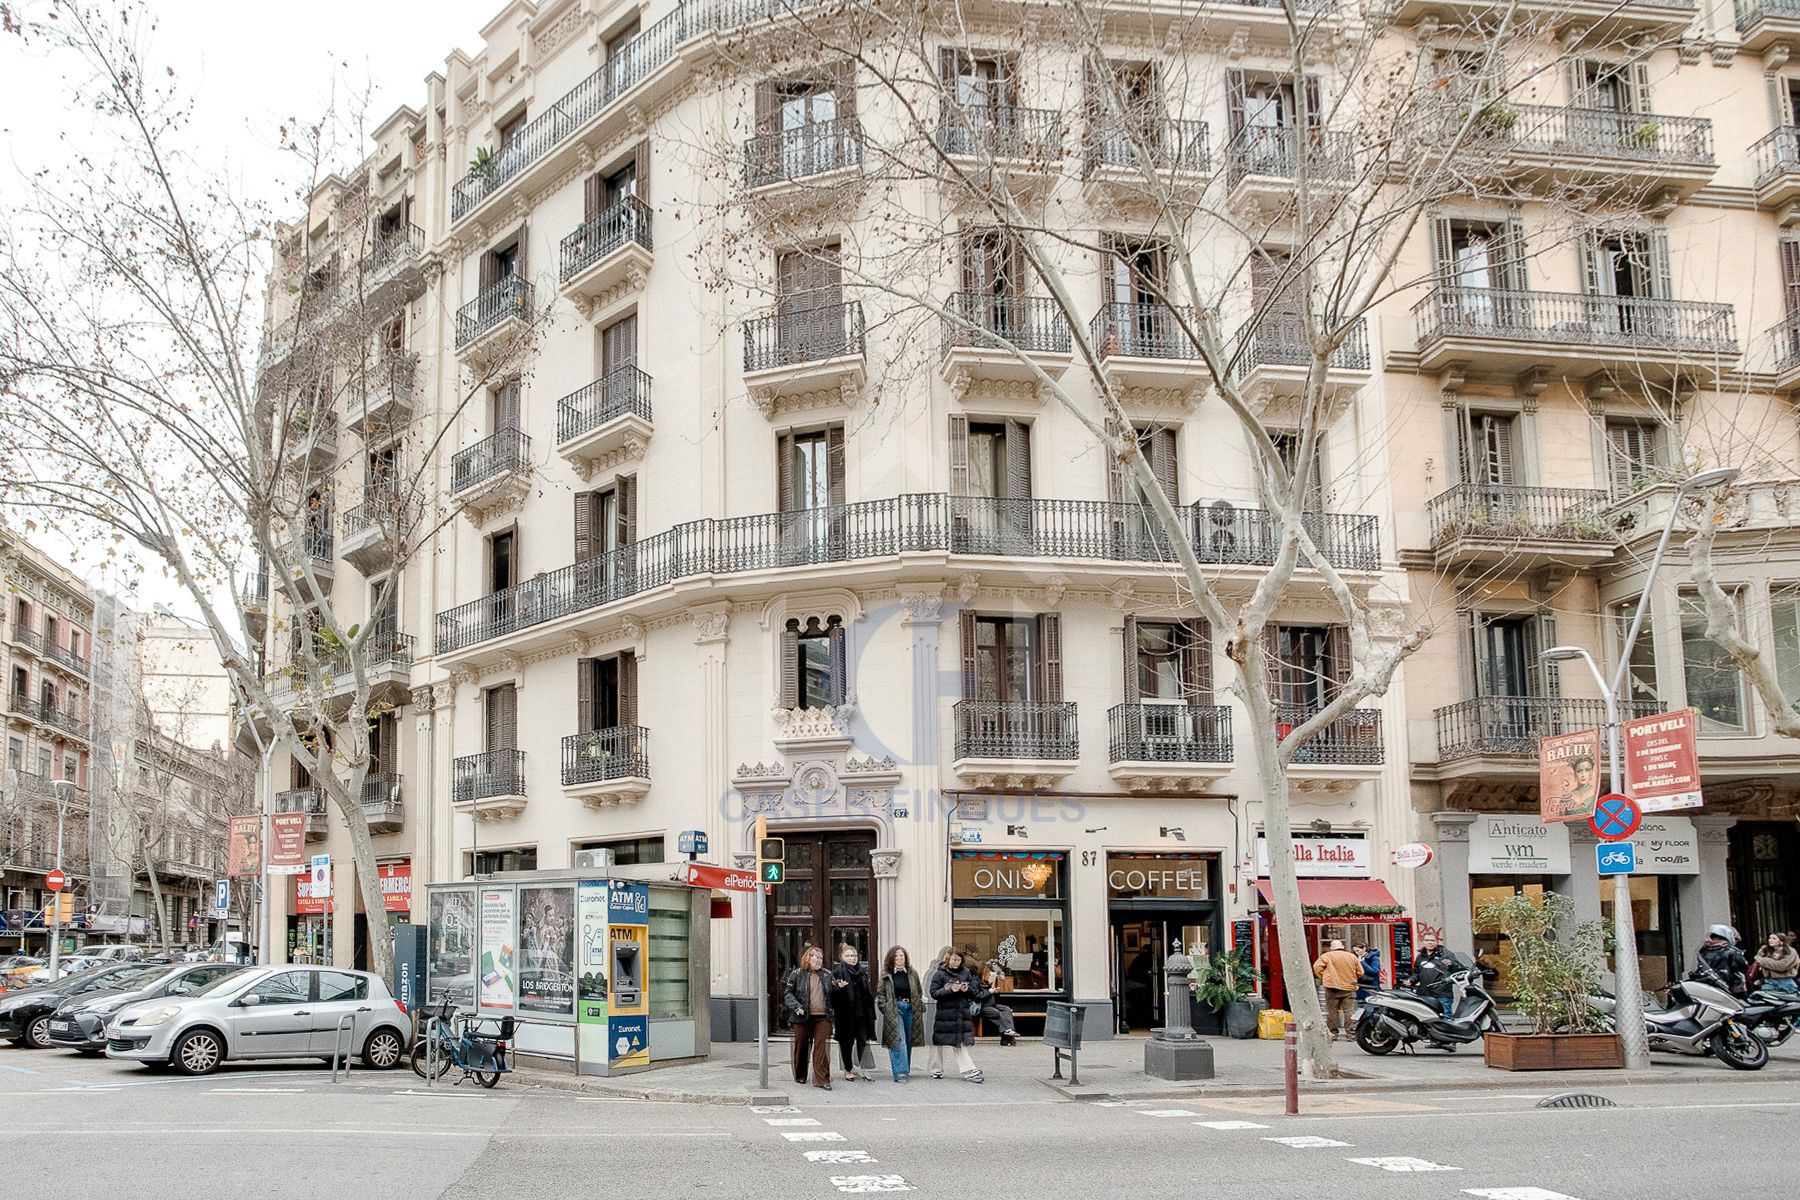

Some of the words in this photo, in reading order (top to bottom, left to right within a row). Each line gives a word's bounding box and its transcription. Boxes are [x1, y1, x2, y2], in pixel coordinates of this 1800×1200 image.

[1630, 723, 1659, 738] PORT
[1660, 718, 1687, 732] VELL
[1491, 823, 1547, 836] Anticato
[680, 834, 694, 843] ATM
[695, 834, 708, 843] ATM
[1082, 851, 1097, 867] 87
[1293, 844, 1314, 861] lla
[1317, 844, 1356, 862] Italia
[689, 868, 699, 882] P
[974, 869, 1035, 889] ONIS
[1108, 870, 1203, 890] COFFEE
[218, 883, 227, 907] P
[611, 891, 634, 904] ATM
[446, 914, 460, 928] Q3
[610, 928, 633, 940] ATM
[523, 980, 535, 990] LOS
[535, 981, 574, 993] BRIDGERTON
[618, 1025, 642, 1033] Euronet
